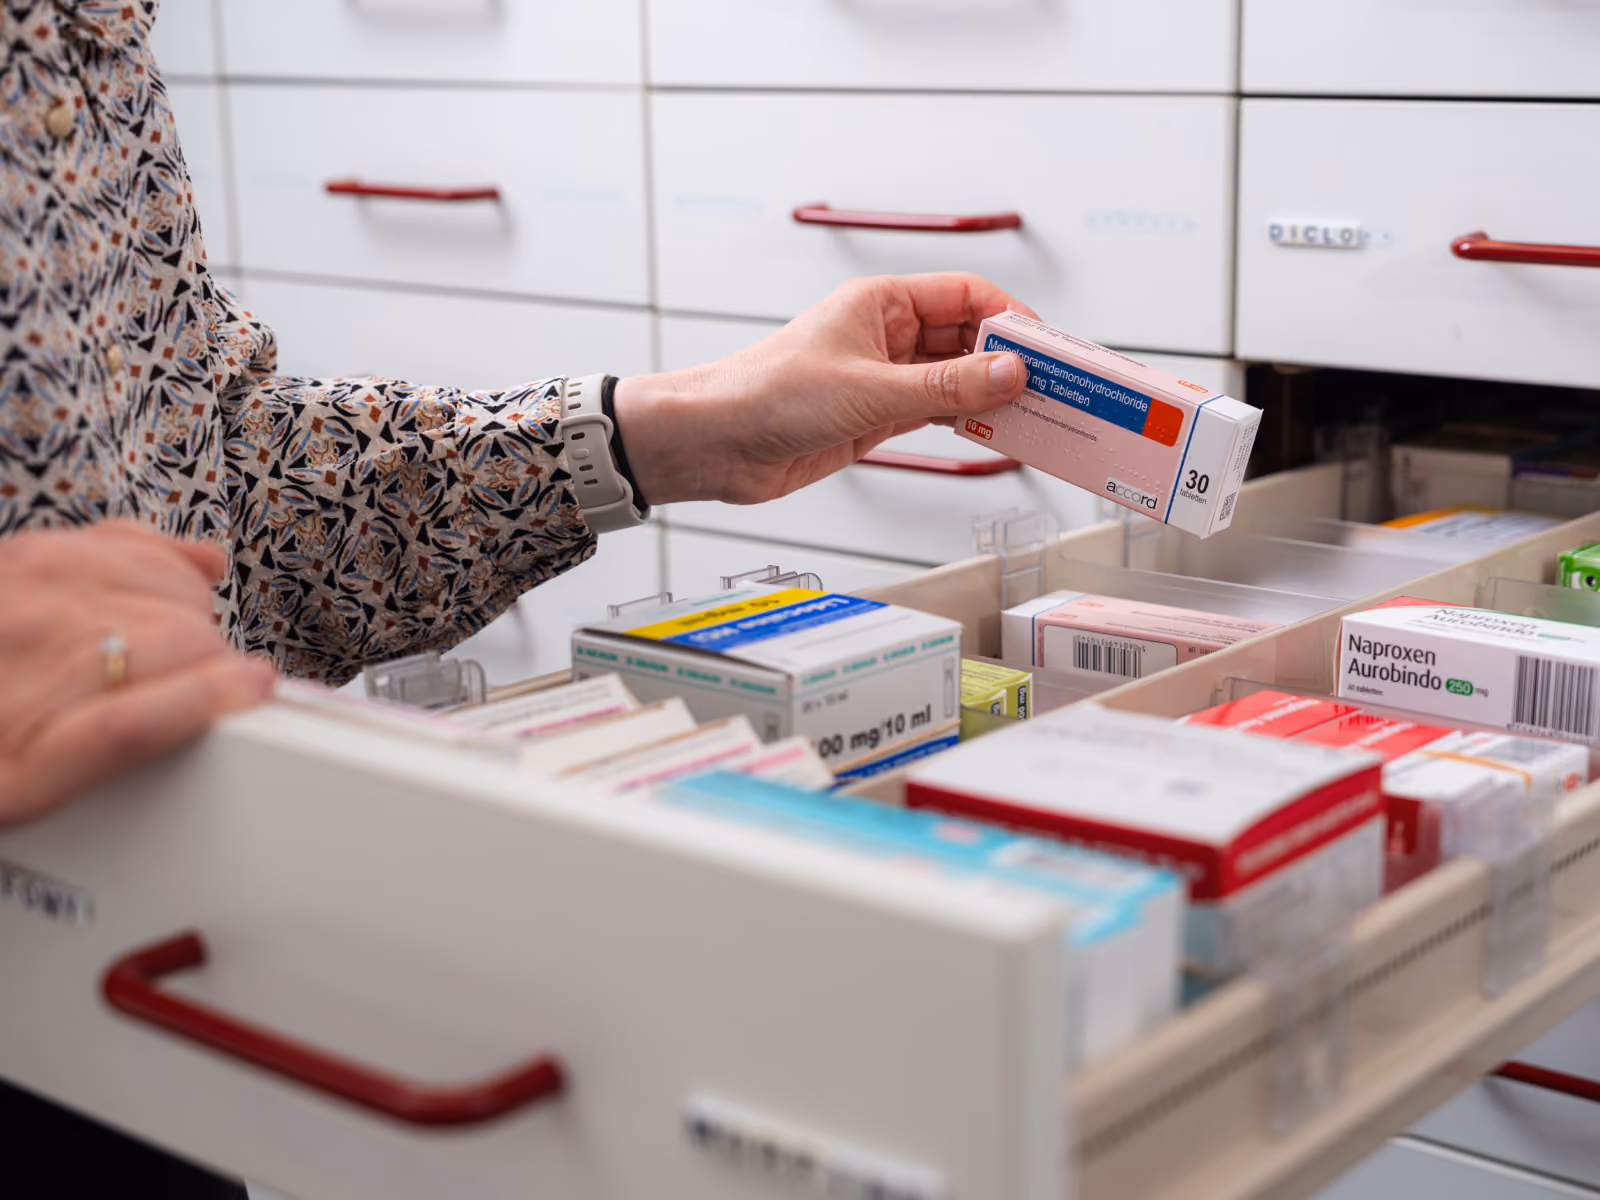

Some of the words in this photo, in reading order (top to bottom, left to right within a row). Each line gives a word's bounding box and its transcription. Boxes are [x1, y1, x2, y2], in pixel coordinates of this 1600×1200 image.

[1032, 375, 1047, 391] mg
[1049, 379, 1090, 407] Tabletten
[966, 419, 978, 431] 10
[978, 426, 993, 440] mg
[1185, 468, 1210, 494] 30
[1105, 481, 1158, 510] accord
[1180, 488, 1208, 505] tabletten
[1424, 612, 1536, 637] Aurobindo
[1435, 607, 1538, 631] Naproxen
[1348, 633, 1437, 666] Naproxen
[1347, 657, 1442, 690] Aurobindo
[1448, 679, 1472, 694] 250
[1475, 687, 1489, 698] mg
[1018, 687, 1027, 704] mg
[818, 734, 844, 759] 00
[910, 703, 932, 729] ml
